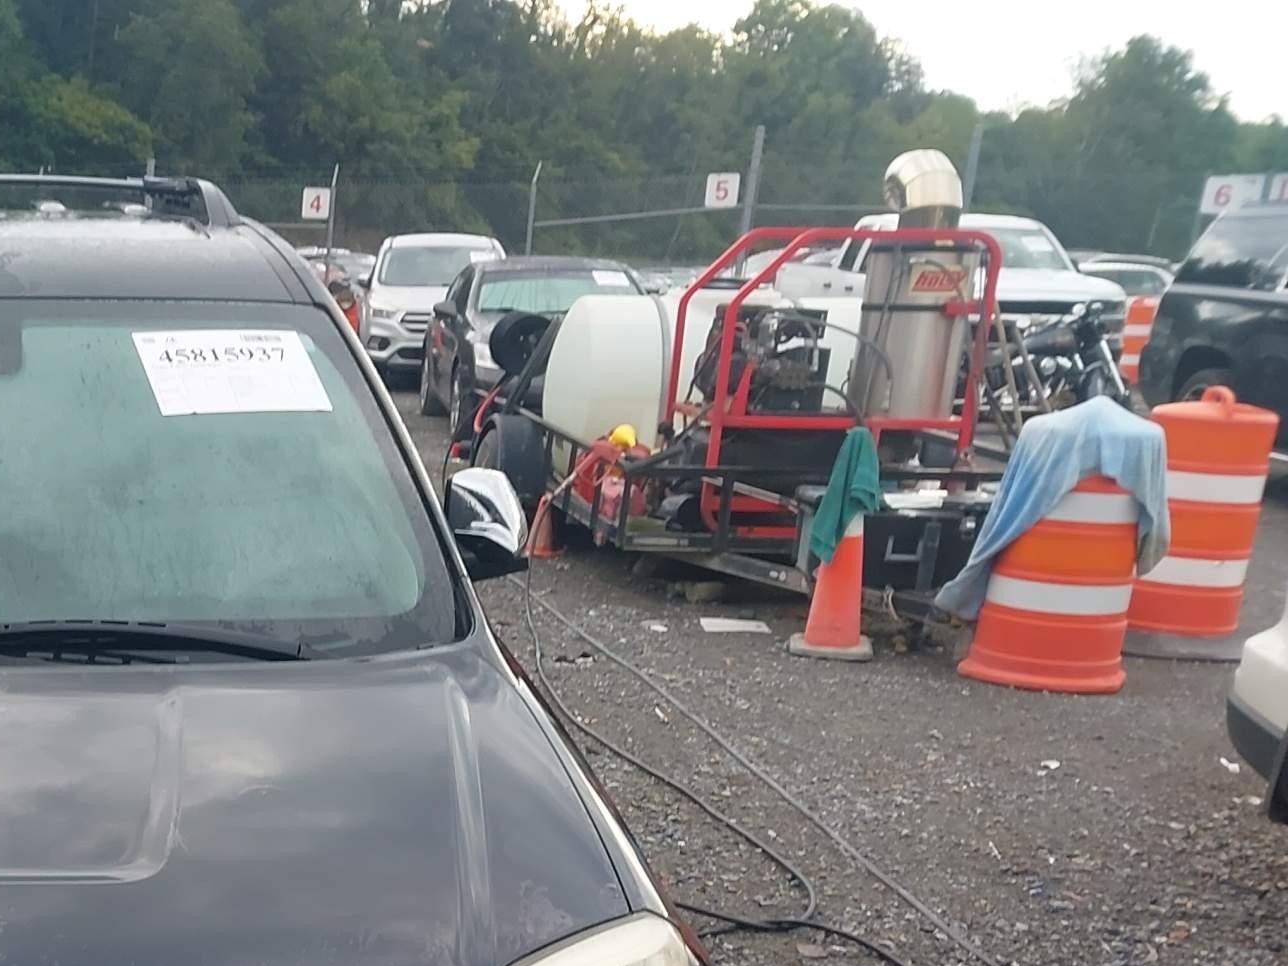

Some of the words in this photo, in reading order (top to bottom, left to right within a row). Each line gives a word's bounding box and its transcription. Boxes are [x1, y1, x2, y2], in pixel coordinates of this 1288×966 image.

[715, 180, 729, 201] 5
[1213, 184, 1233, 208] 6
[310, 194, 322, 213] 4
[159, 346, 286, 363] 45815937
